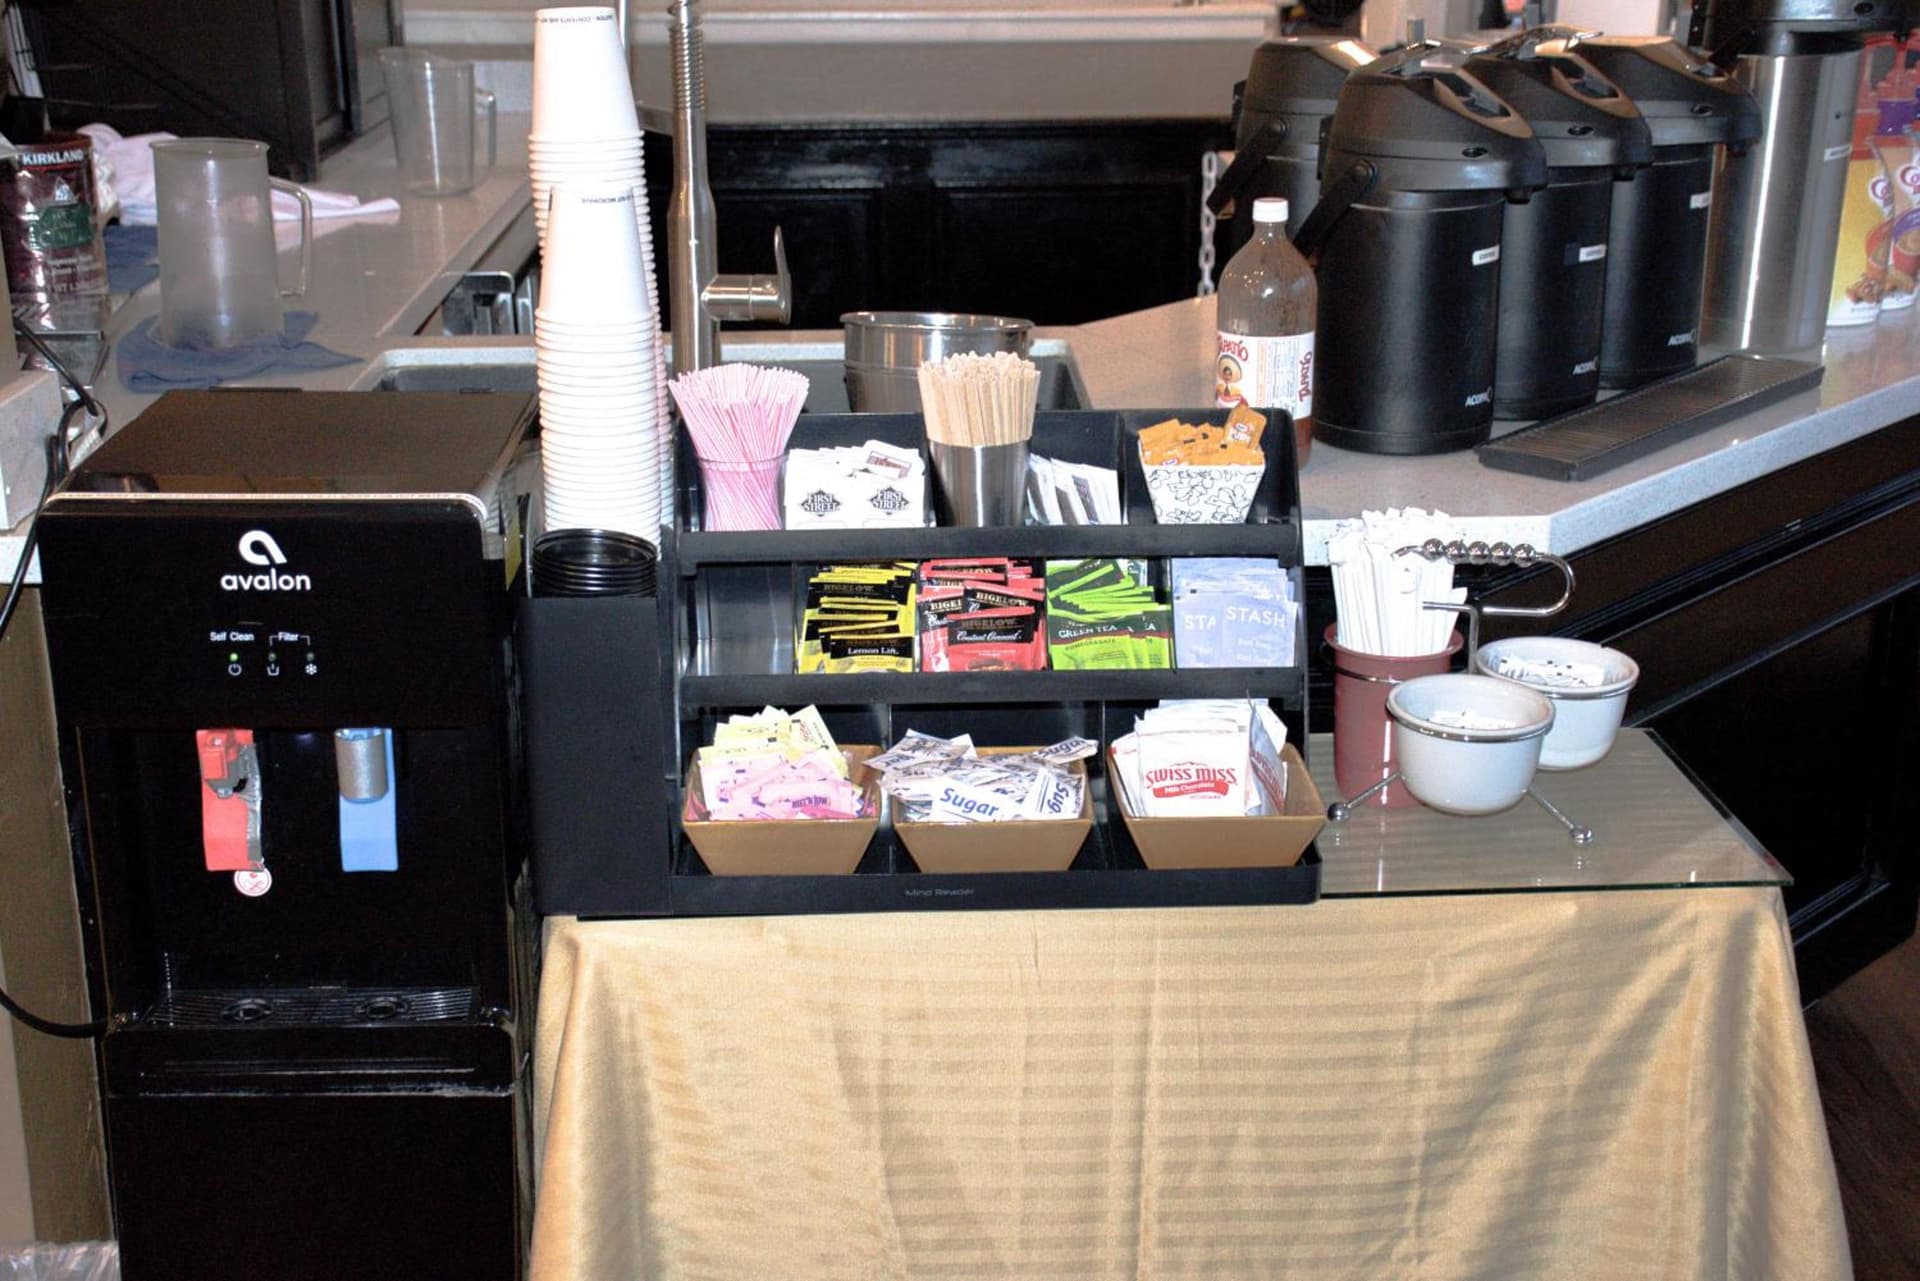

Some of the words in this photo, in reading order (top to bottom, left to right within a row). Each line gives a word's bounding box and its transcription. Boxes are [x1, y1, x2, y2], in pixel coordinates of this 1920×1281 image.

[22, 150, 85, 166] KIRKLAND
[807, 493, 834, 503] FIRST
[877, 490, 904, 501] FIRST
[804, 503, 841, 513] STREET
[873, 500, 910, 511] STREET
[220, 567, 312, 591] avalon
[975, 592, 1029, 607] BIGELOW
[1184, 615, 1217, 631] STA
[1226, 606, 1287, 629] STASH
[210, 632, 227, 641] Self
[230, 632, 254, 641] Clean
[278, 632, 299, 641] Filter
[1058, 628, 1094, 638] GREEN
[1095, 625, 1118, 634] TEA
[847, 647, 879, 655] Lemon
[940, 787, 1000, 817] Sugar
